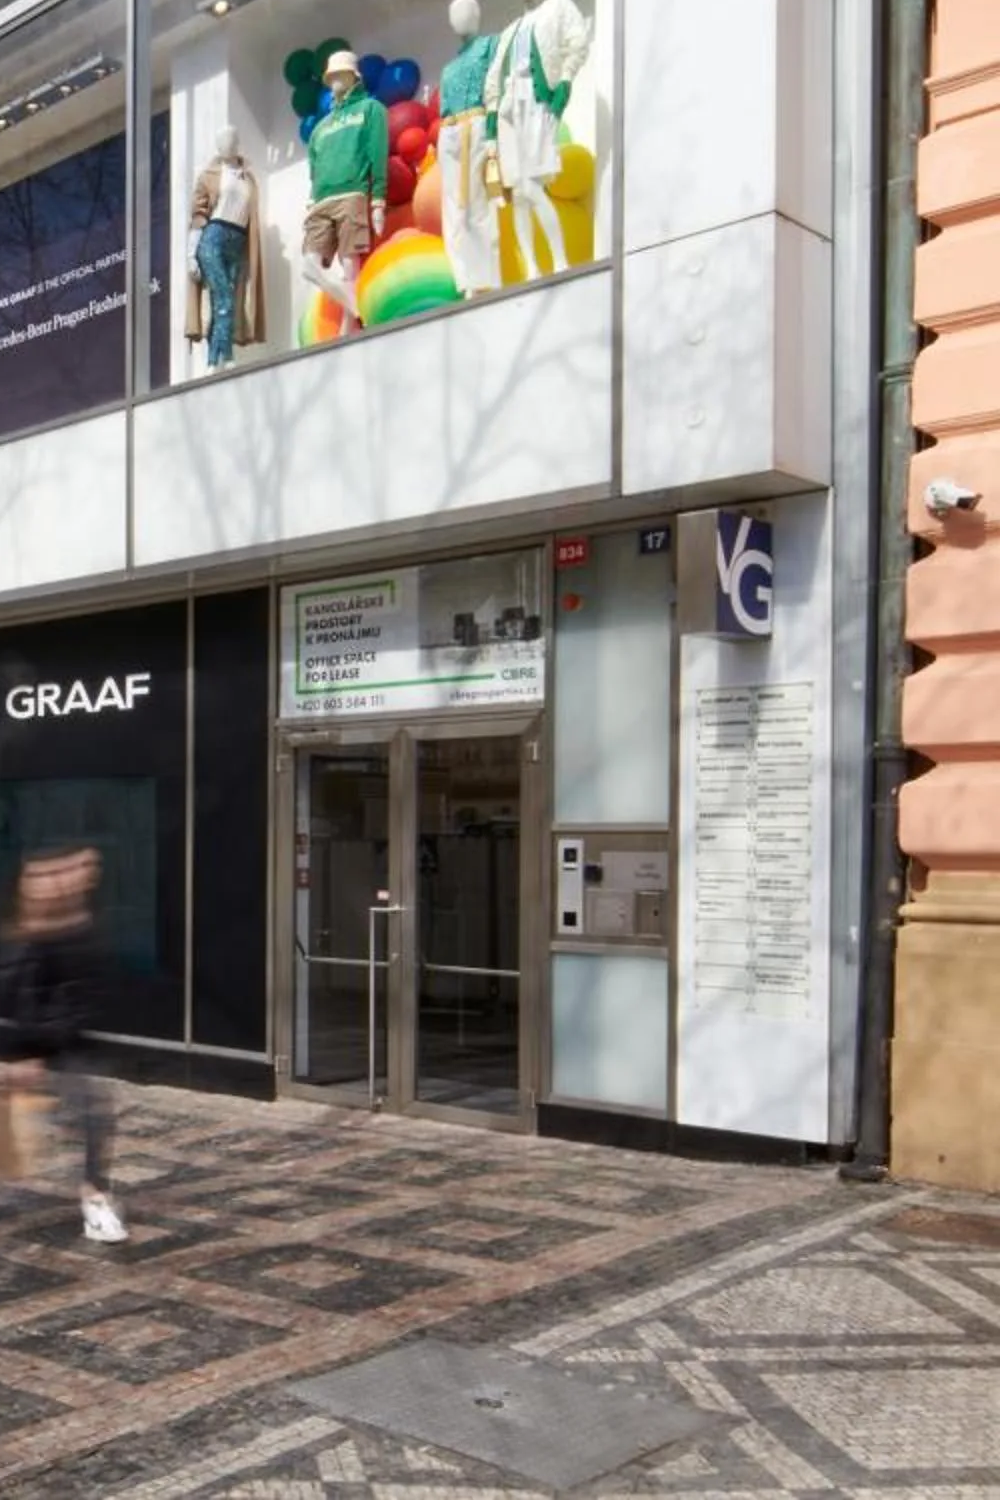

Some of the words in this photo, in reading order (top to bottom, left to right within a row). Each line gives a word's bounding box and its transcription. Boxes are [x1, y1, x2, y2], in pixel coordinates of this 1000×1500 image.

[45, 277, 60, 292] THE
[95, 249, 130, 271] PARTNE
[53, 306, 89, 331] Prague
[643, 532, 665, 549] 17
[305, 655, 341, 669] OFFICE
[343, 651, 376, 665] SPACE
[305, 670, 327, 683] FOR
[329, 668, 361, 682] LEASE
[6, 673, 152, 720] GRAAF
